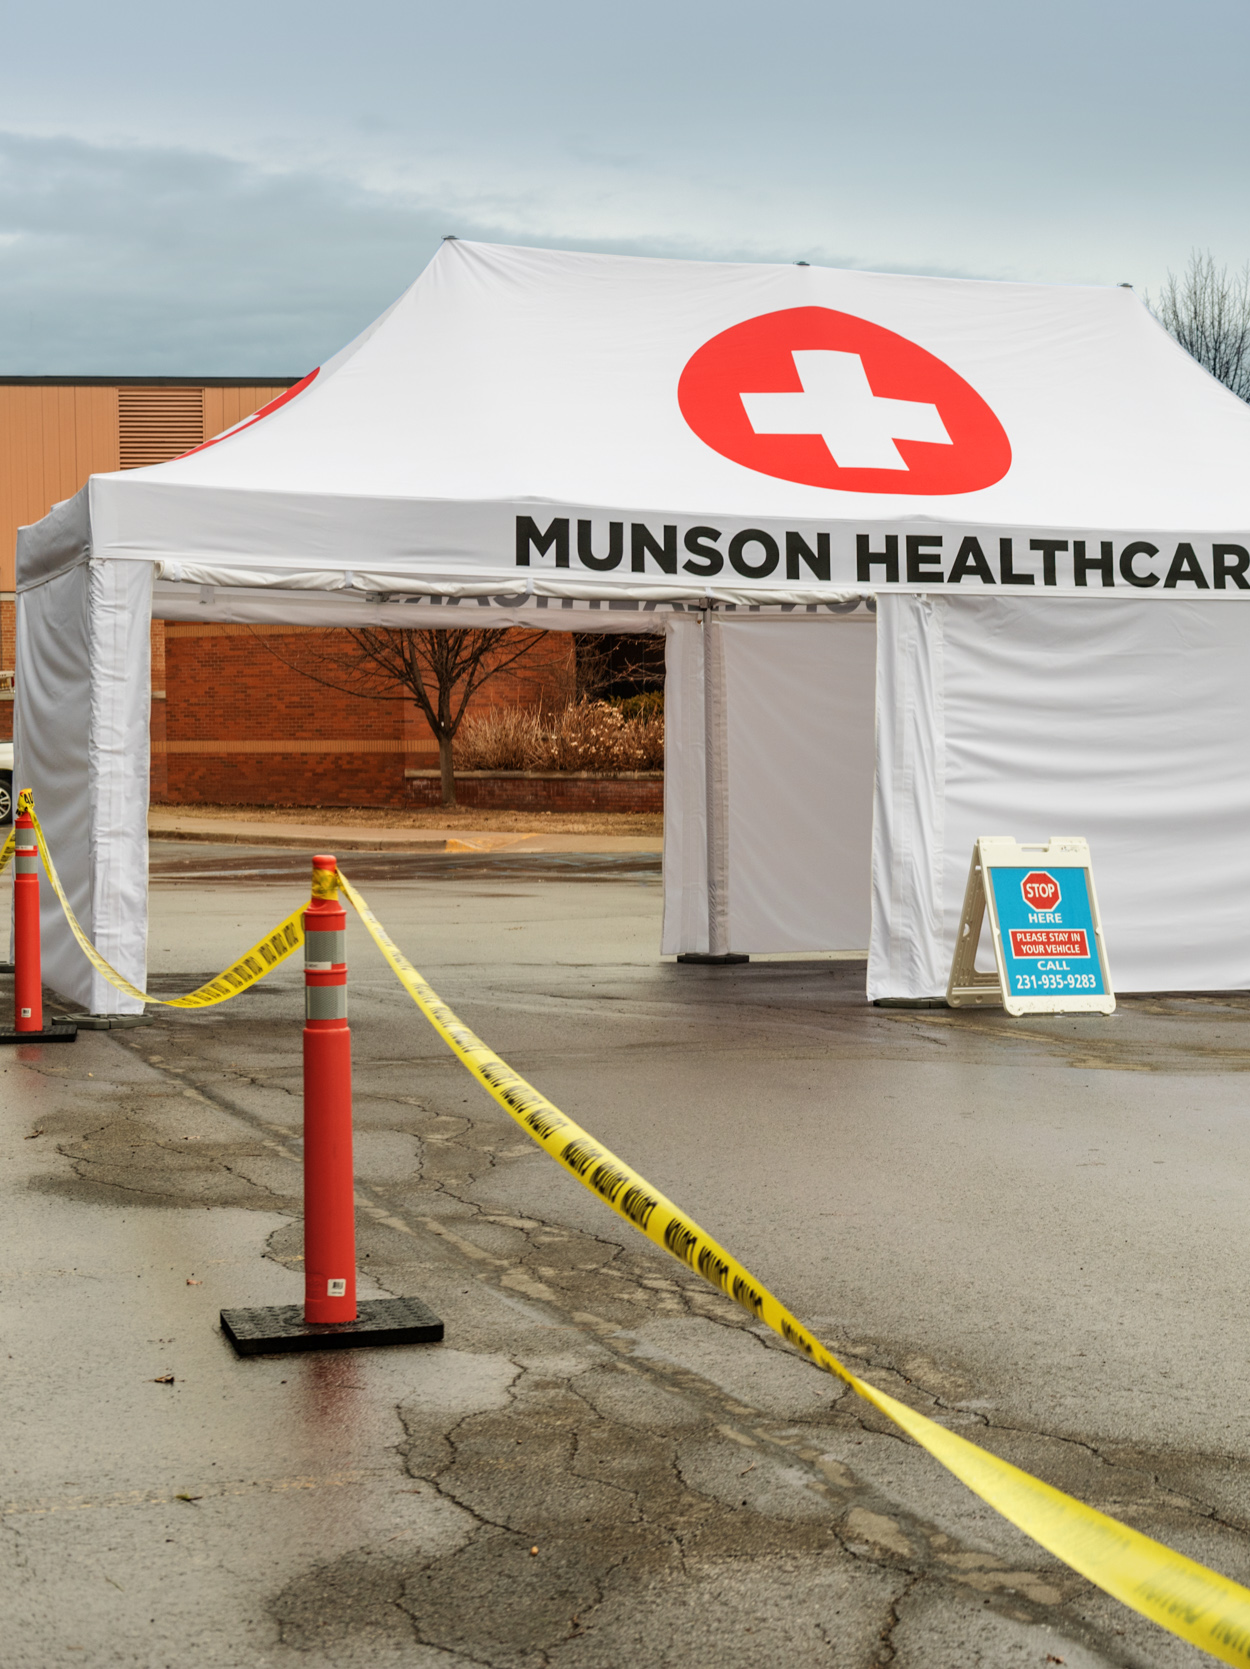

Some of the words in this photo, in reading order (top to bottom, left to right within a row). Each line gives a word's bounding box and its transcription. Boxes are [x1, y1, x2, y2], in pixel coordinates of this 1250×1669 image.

[516, 515, 831, 581] MUNSON
[1026, 883, 1055, 898] STOP
[1028, 913, 1062, 923] HERE
[1016, 932, 1047, 942] PLEASE
[1049, 932, 1069, 942] STAY
[1071, 932, 1081, 942] IN
[1021, 944, 1046, 954] YOUR
[1046, 944, 1080, 954] VEHICLE
[1037, 961, 1070, 971] CALL
[1015, 974, 1096, 989] 231-935-9283
